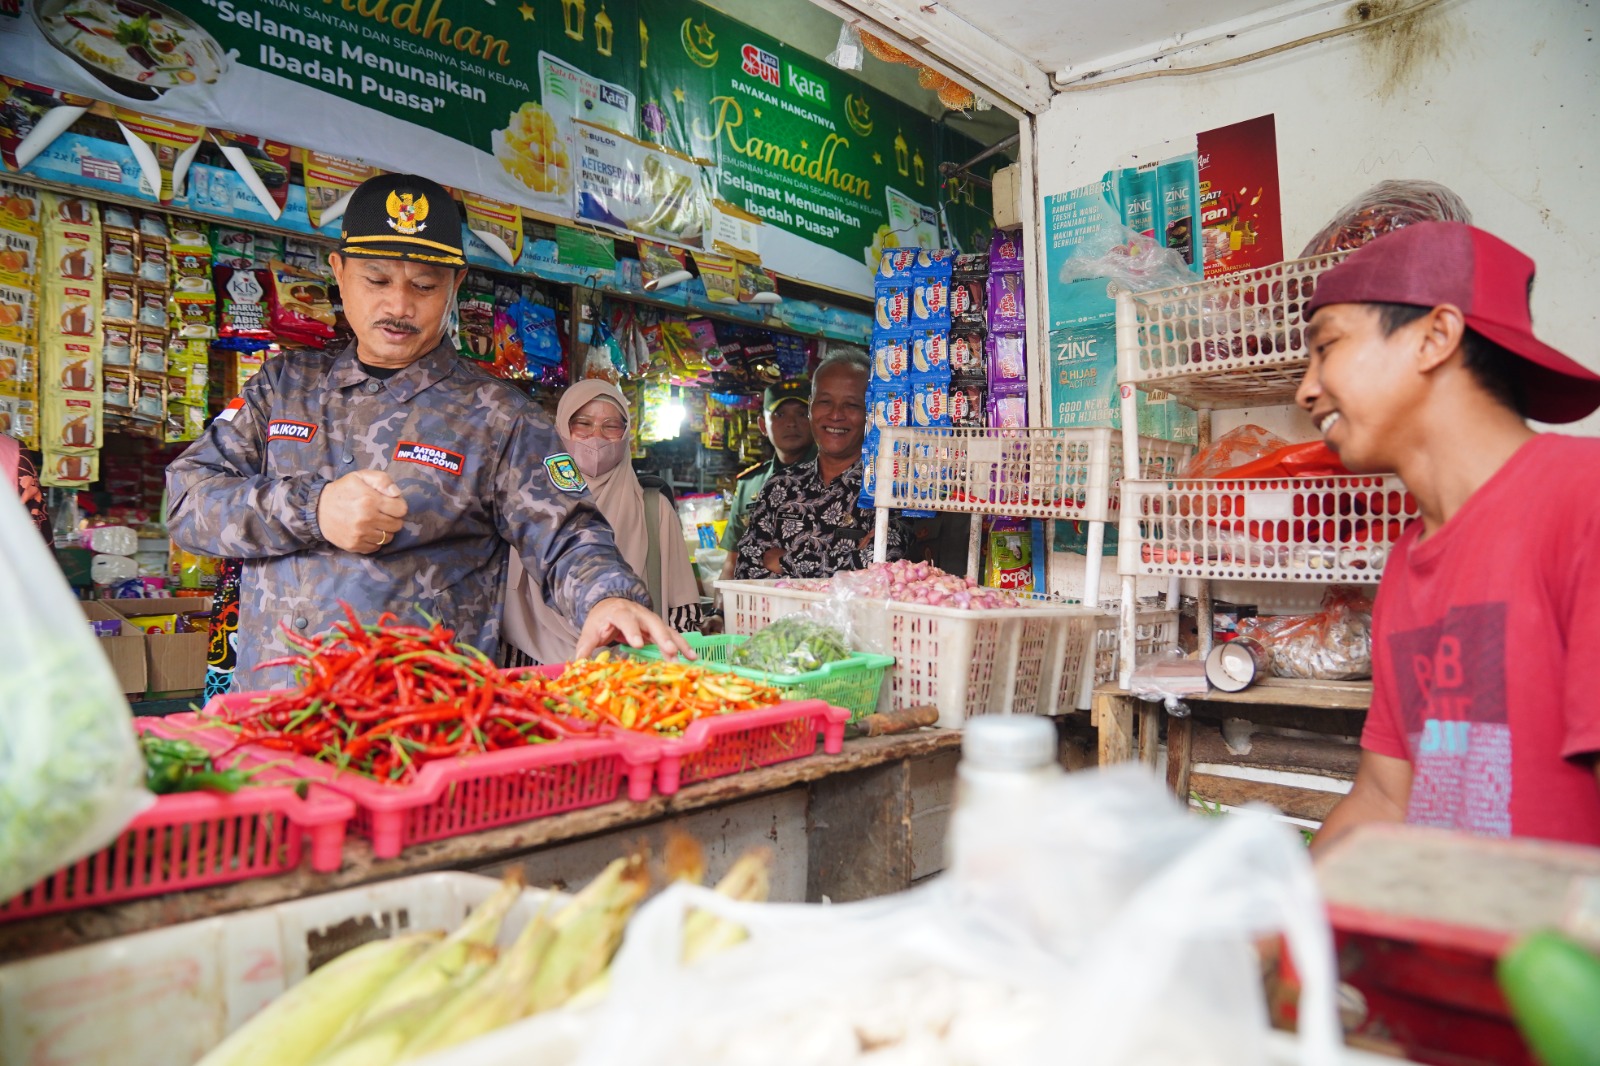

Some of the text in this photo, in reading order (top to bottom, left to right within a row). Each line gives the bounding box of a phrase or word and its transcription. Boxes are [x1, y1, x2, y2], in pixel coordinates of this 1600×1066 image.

[303, 7, 359, 34] SANTAN
[362, 27, 390, 45] DAN
[393, 38, 458, 68] SEGARNYA
[460, 61, 486, 77] SARI
[488, 71, 530, 93] KELAPA
[260, 44, 446, 114] Ibadah Puasa”
[341, 40, 487, 104] Menunaikan
[788, 64, 826, 102] kara
[602, 86, 626, 107] kara
[731, 79, 837, 131] RAYAKAN HANGATNYA
[588, 132, 616, 147] BULOG
[692, 96, 872, 199] Ramadhan
[764, 170, 794, 185] SANTAN
[794, 179, 809, 191] DAN
[810, 185, 844, 203] SEGARNYA
[845, 198, 860, 210] SARI
[860, 203, 883, 217] KELAPA
[1165, 187, 1189, 202] ZINC
[744, 198, 840, 238] Ibadah Puasa”
[784, 191, 861, 228] Menunaikan
[1053, 211, 1072, 222] FRESH
[1127, 199, 1152, 215] ZINC
[1202, 207, 1228, 223] ran
[1053, 216, 1087, 230] SEPANJANG
[1054, 224, 1101, 240] MAKIN NYAMAN
[229, 304, 263, 312] HARUM
[890, 292, 903, 323] Tango
[929, 281, 942, 313] Tango
[954, 284, 967, 317] Tango
[235, 316, 260, 324] ABIS
[891, 344, 903, 377] Tango
[929, 333, 941, 366] Tango
[954, 337, 966, 370] Tango
[1057, 338, 1098, 361] ZINC
[1069, 367, 1098, 380] HIJAB
[1069, 379, 1097, 389] ACTIVE
[929, 388, 942, 420] Tango
[953, 390, 966, 422] Tango
[1059, 398, 1110, 414] GOOD NEWS
[1059, 412, 1076, 424] FOR
[1174, 426, 1197, 438] ZINC
[398, 450, 459, 471] INFLASI-COVID
[413, 445, 447, 460] SATGAS
